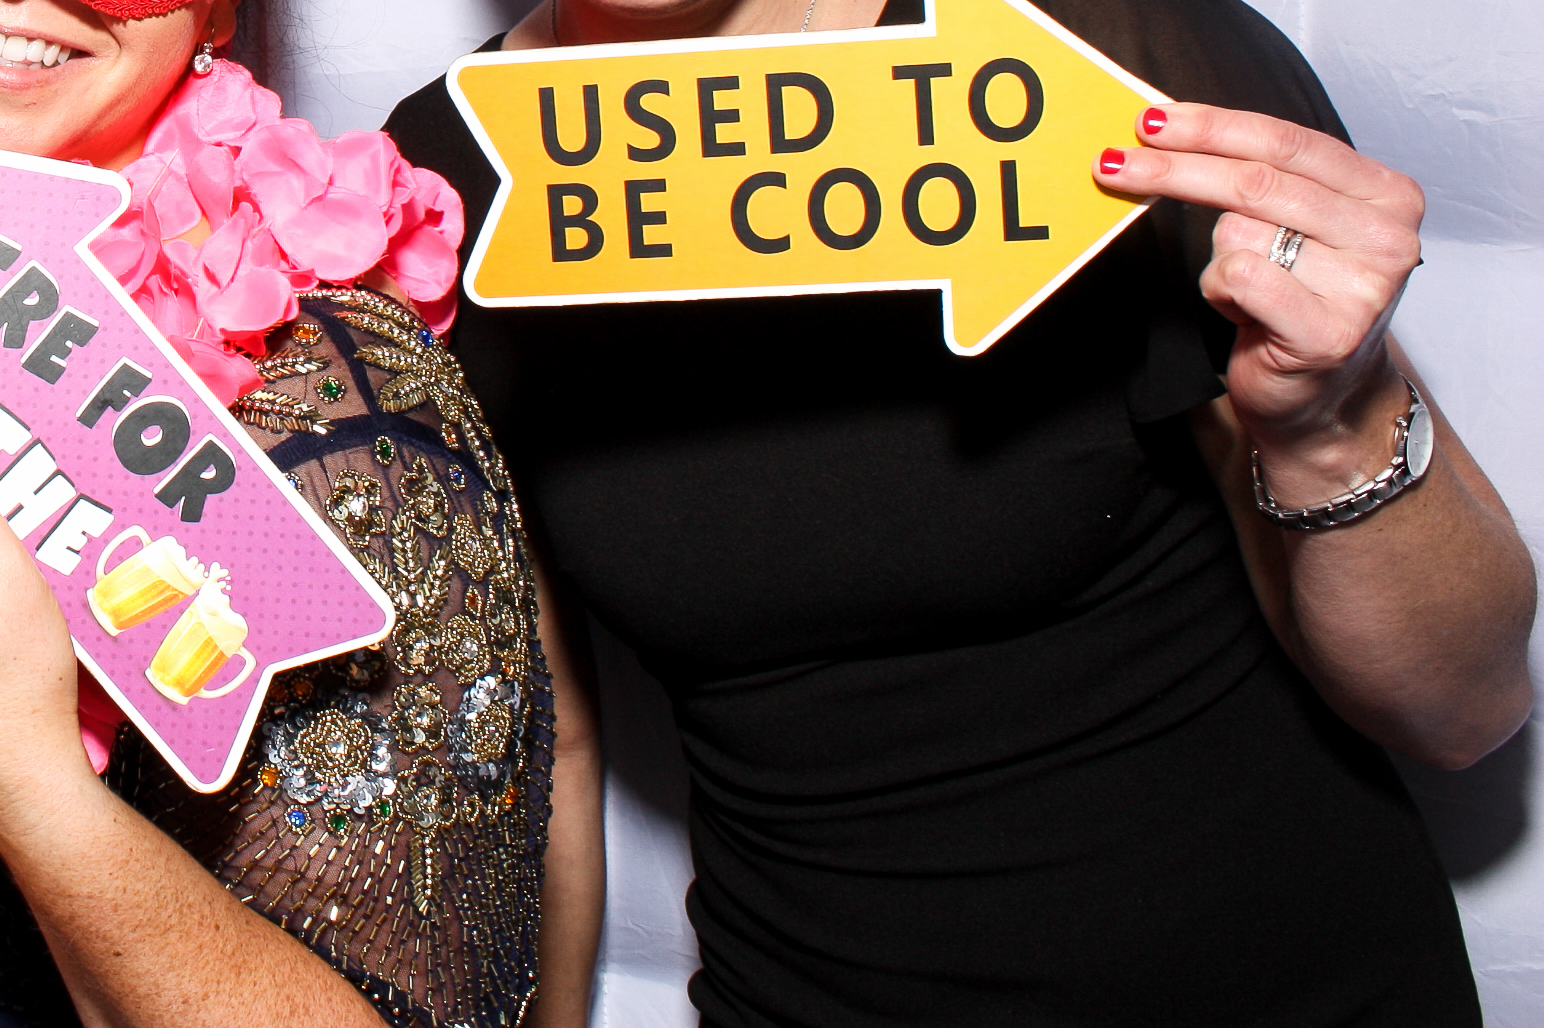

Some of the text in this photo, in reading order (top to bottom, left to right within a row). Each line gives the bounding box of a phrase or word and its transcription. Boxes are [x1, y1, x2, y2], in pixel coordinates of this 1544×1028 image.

[538, 57, 1044, 167] USED TO
[546, 160, 1050, 263] BE COOL
[75, 355, 237, 524] FOR
